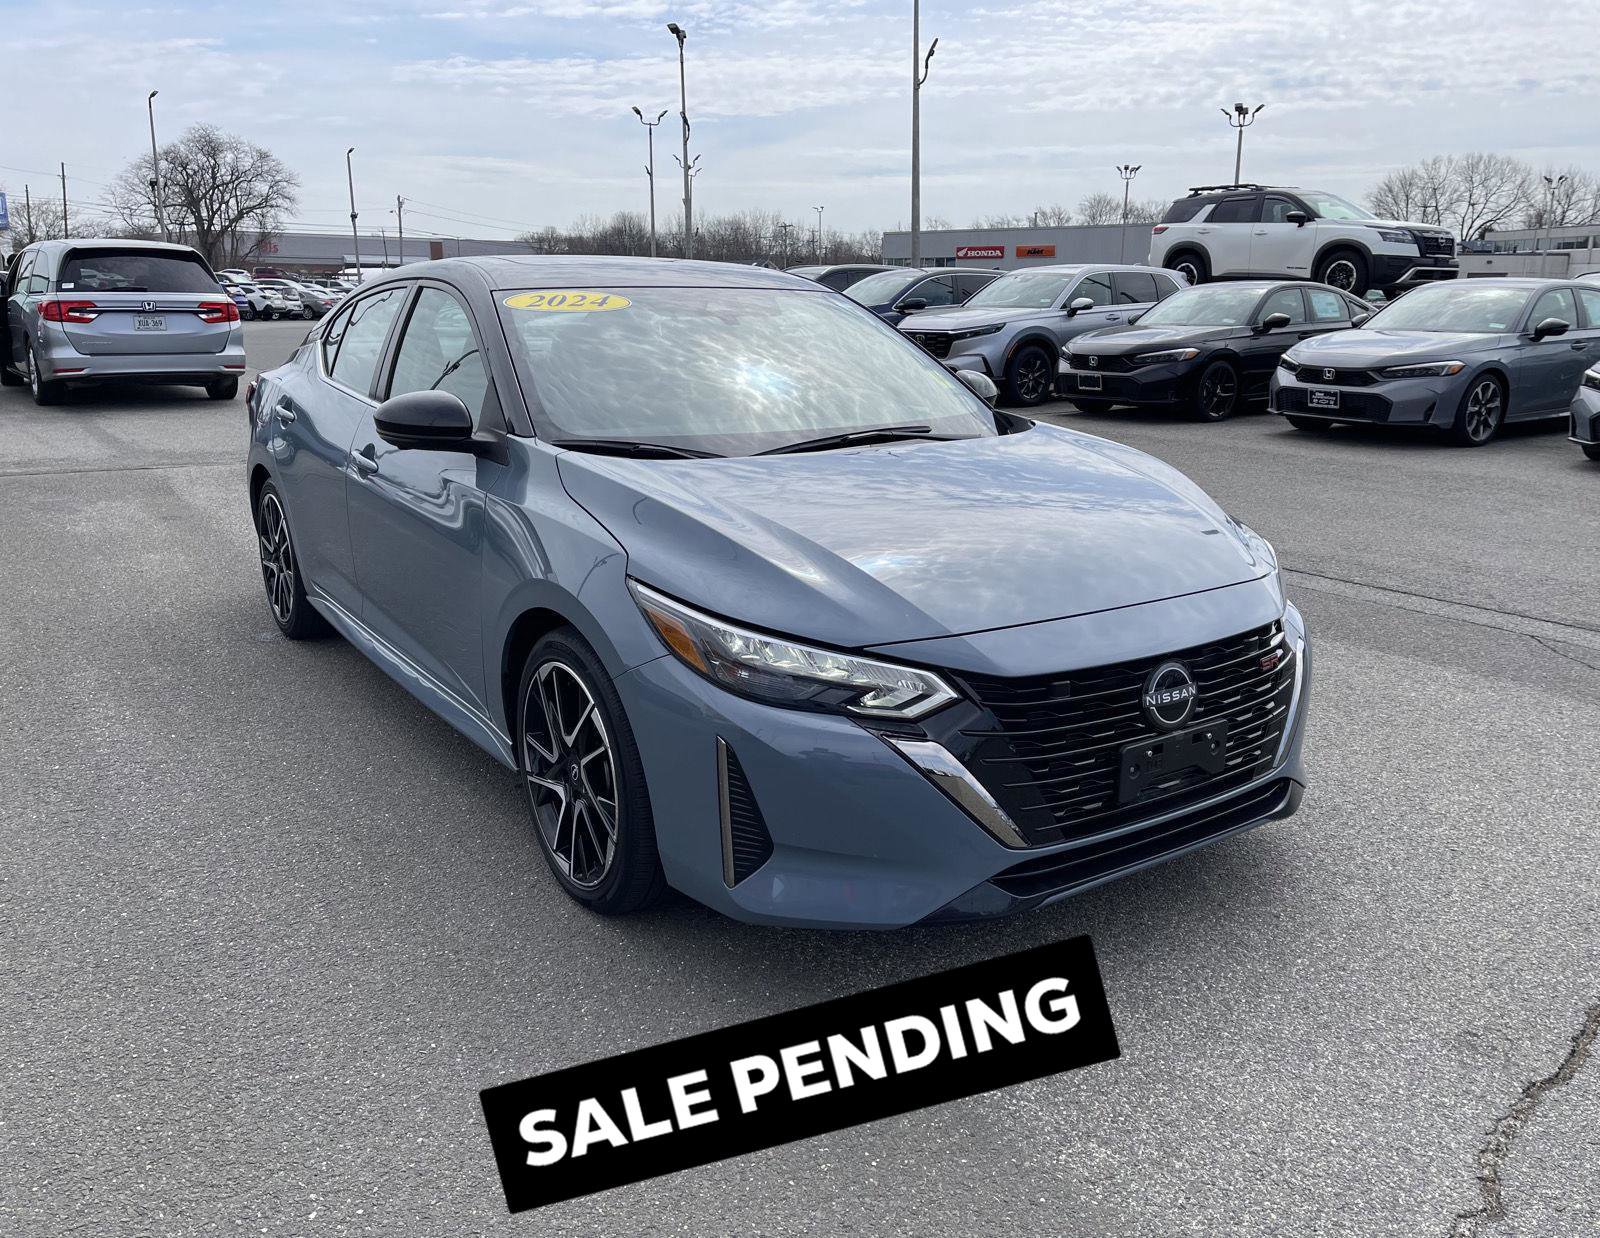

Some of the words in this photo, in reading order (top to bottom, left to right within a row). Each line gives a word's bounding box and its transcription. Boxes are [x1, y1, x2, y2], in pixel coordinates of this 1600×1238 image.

[967, 249, 1002, 257] HONDA
[526, 294, 611, 307] 2024
[1146, 685, 1197, 706] NISSAN
